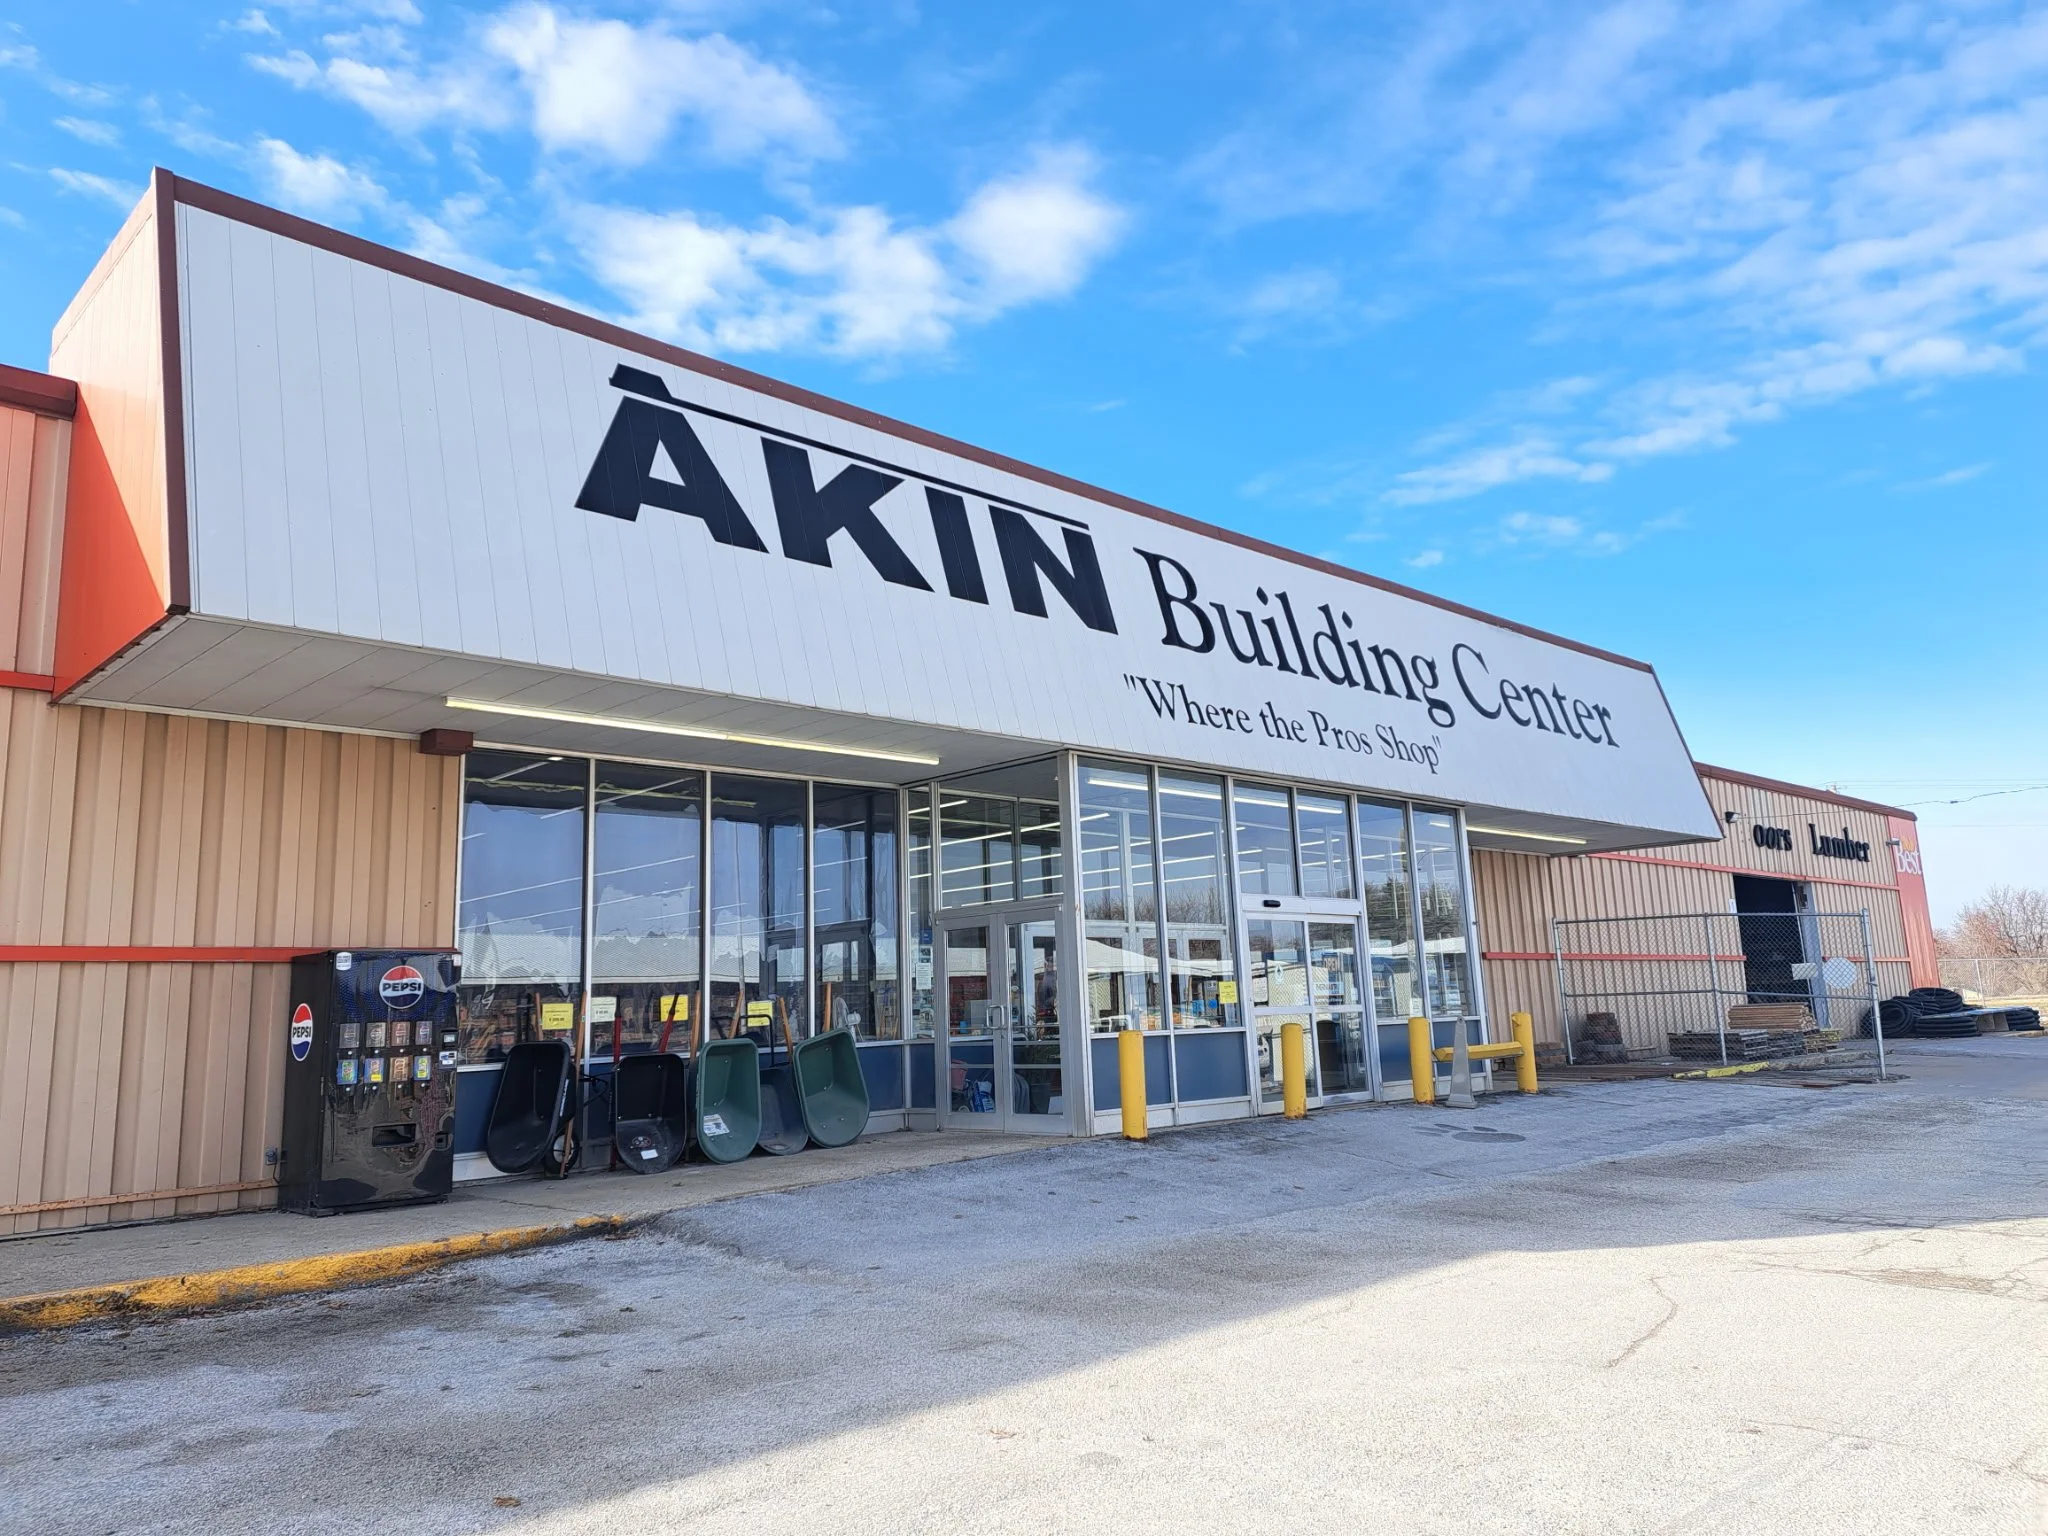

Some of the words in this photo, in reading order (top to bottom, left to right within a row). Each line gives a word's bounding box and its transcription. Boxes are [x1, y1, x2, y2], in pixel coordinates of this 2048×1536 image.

[574, 363, 1119, 636] AKIN
[1133, 546, 1456, 729] Building
[1451, 642, 1621, 749] Center
[1123, 672, 1254, 735] "Where
[1258, 700, 1308, 744] the
[1306, 708, 1373, 756] Pros
[1379, 724, 1443, 775] Shop"
[1808, 823, 1870, 863] Lumber
[1892, 837, 1922, 876] Best
[382, 982, 421, 993] PEPSI
[292, 1025, 312, 1038] PEPSI
